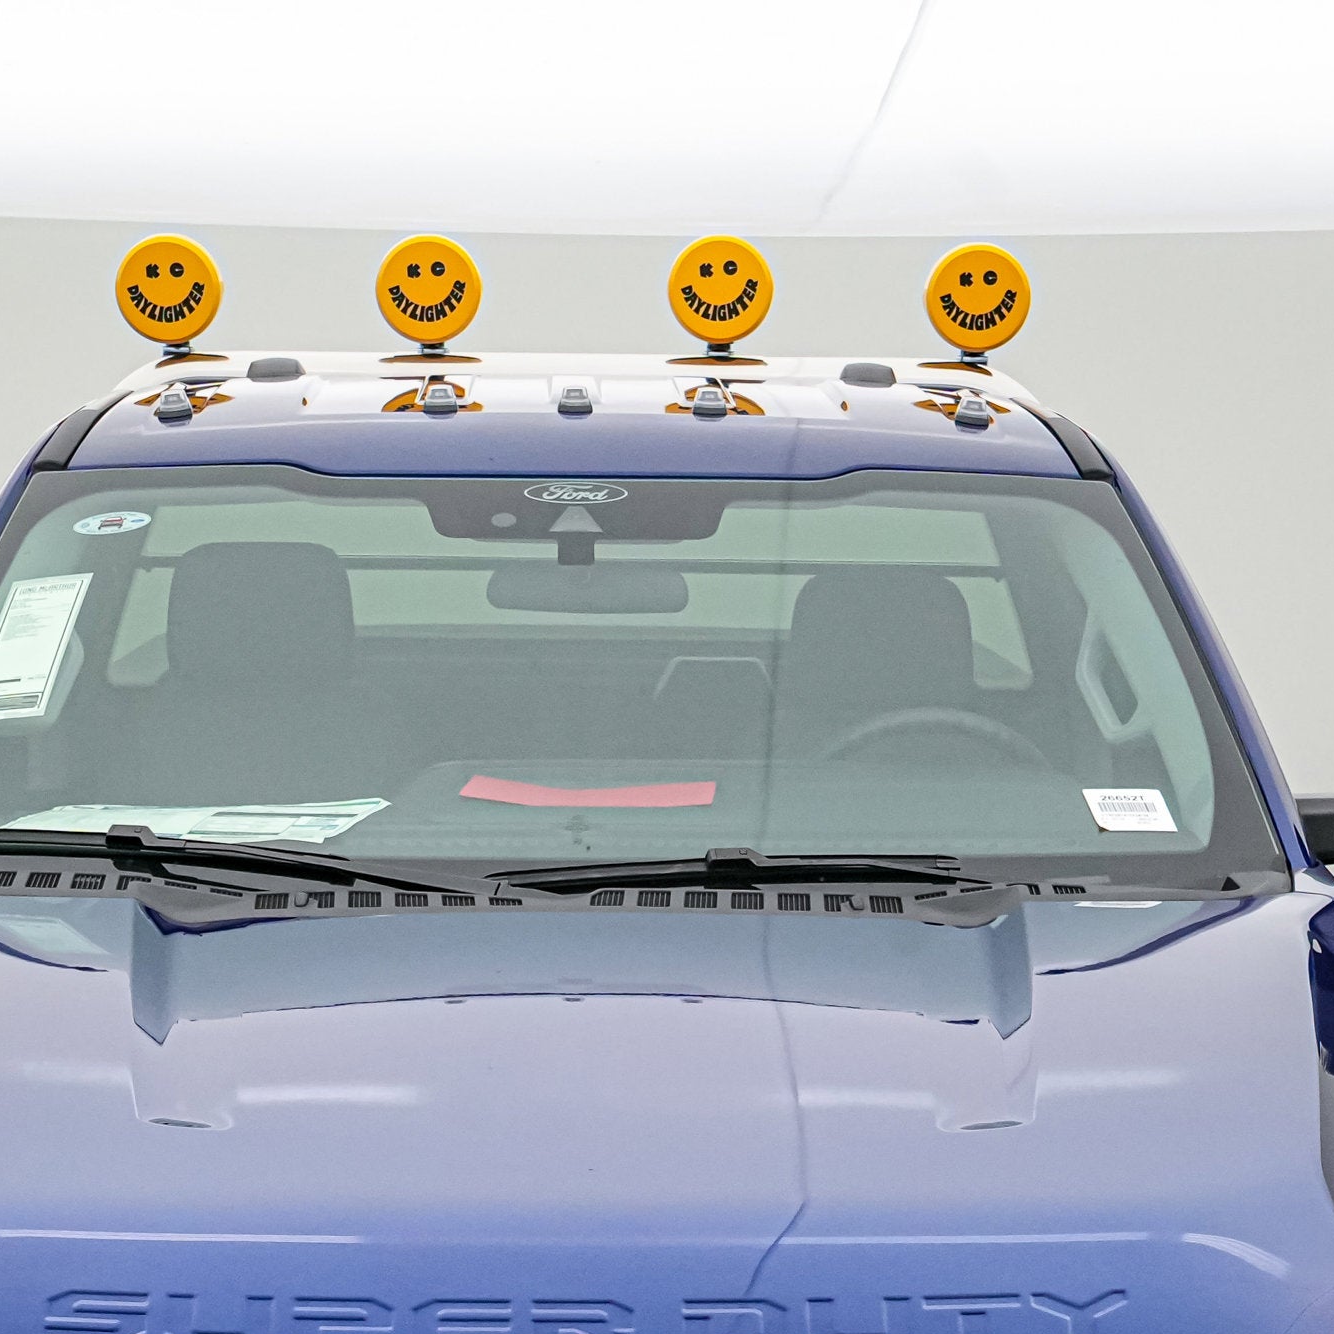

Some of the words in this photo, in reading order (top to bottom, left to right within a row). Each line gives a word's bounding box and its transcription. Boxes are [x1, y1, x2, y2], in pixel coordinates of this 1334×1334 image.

[128, 282, 204, 323] DAYLIGHTER
[389, 281, 465, 322] DAYLIGHTER
[681, 279, 758, 320] DAYLIGHTER
[940, 290, 1016, 330] DAYLIGHTER
[542, 483, 609, 502] Ford
